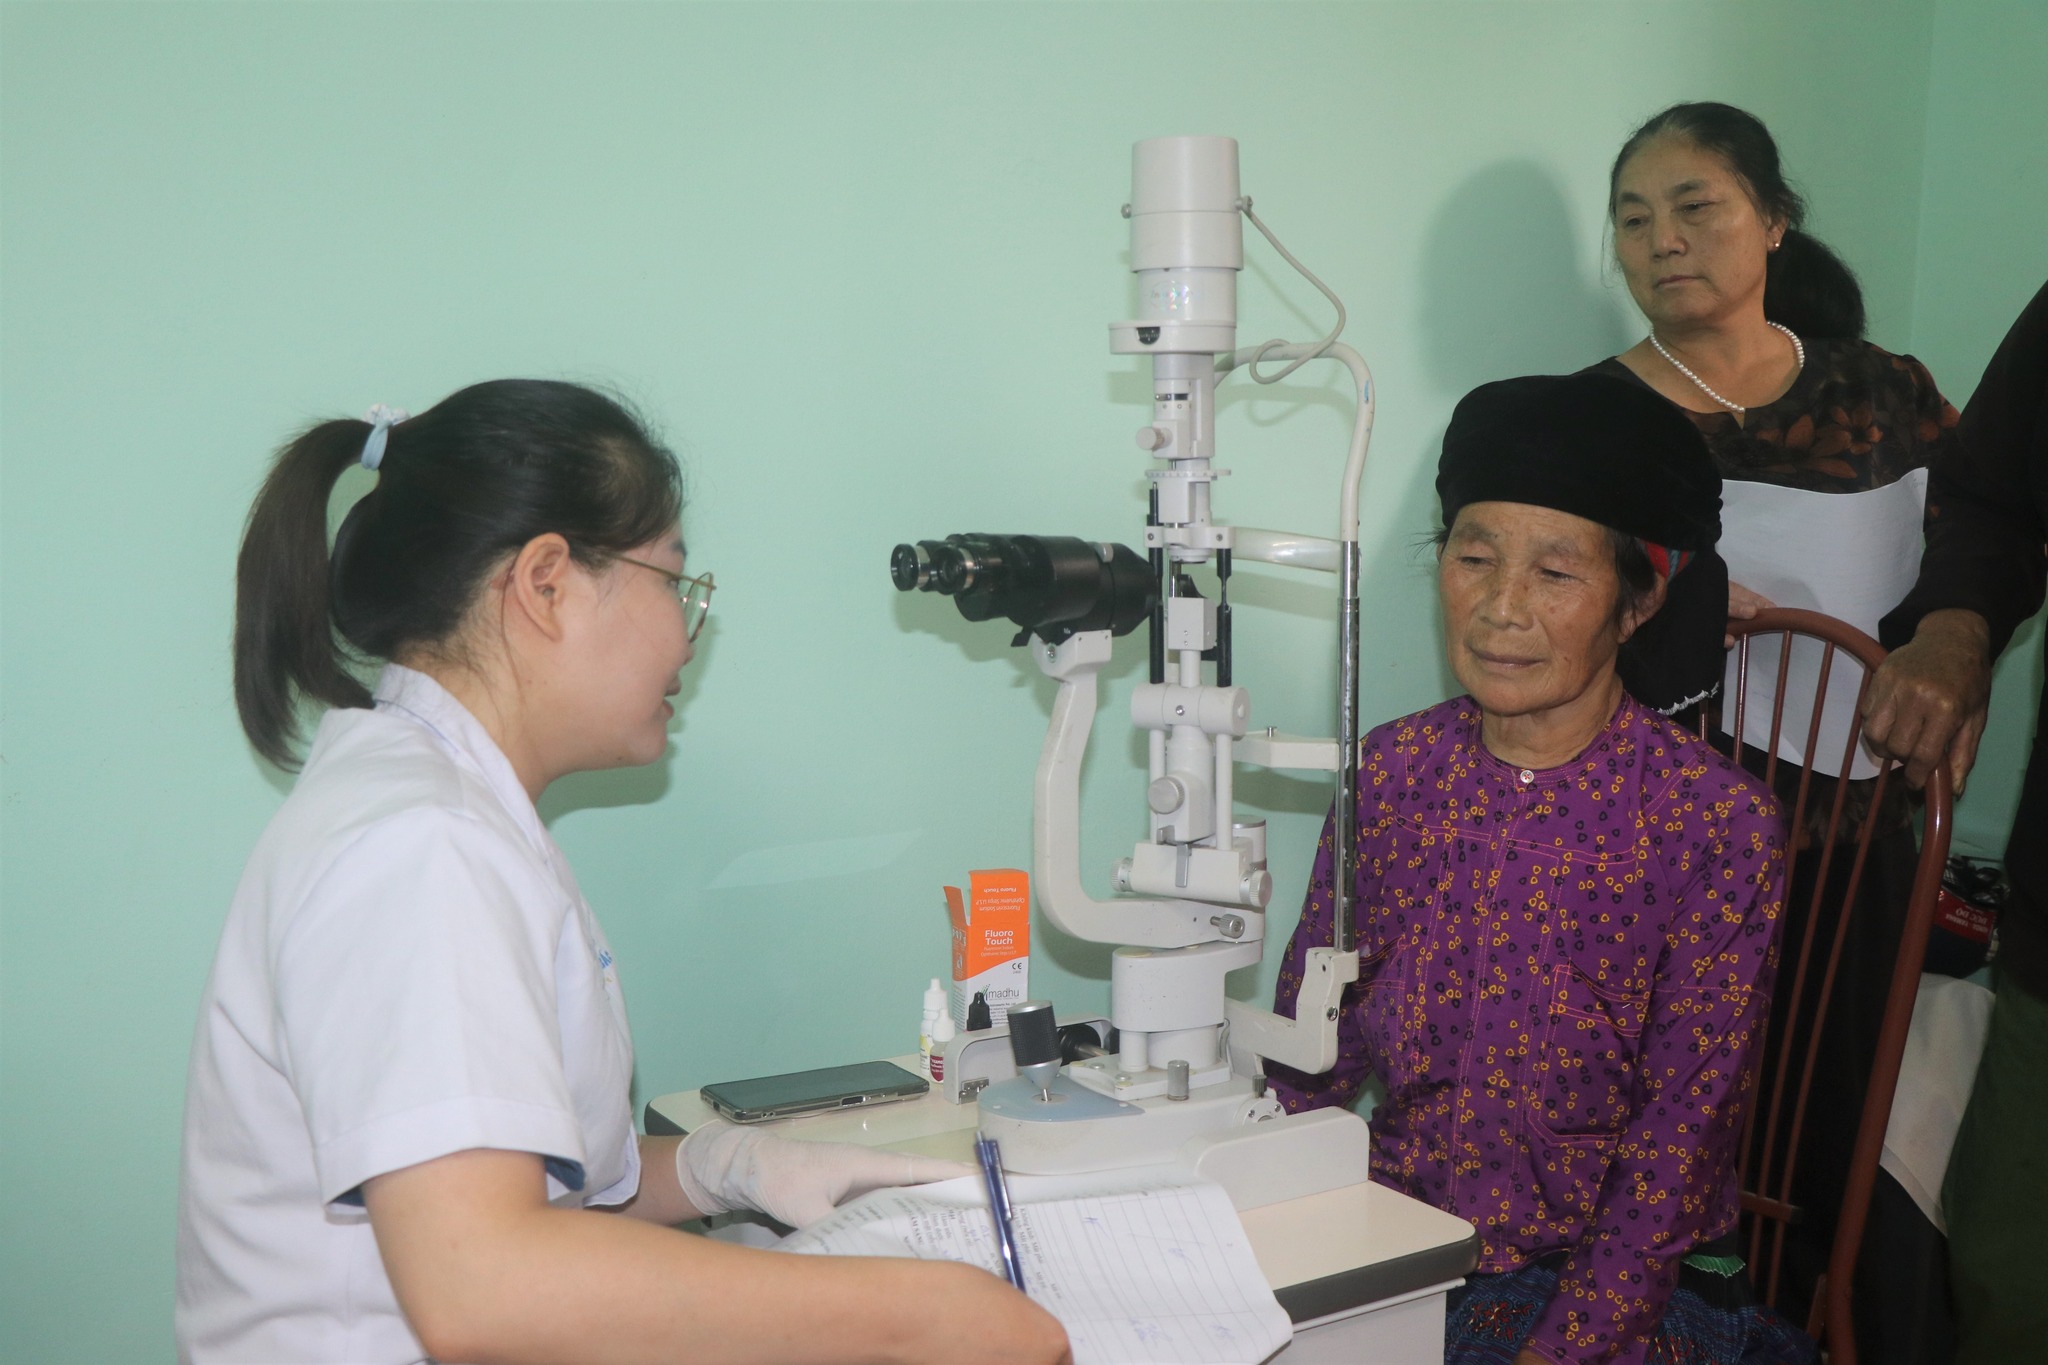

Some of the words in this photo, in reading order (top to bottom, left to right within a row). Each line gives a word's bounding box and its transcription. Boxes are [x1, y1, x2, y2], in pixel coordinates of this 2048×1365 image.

[984, 929, 1014, 938] Fluoro
[985, 937, 1013, 946] Touch
[988, 987, 1020, 999] madhu
